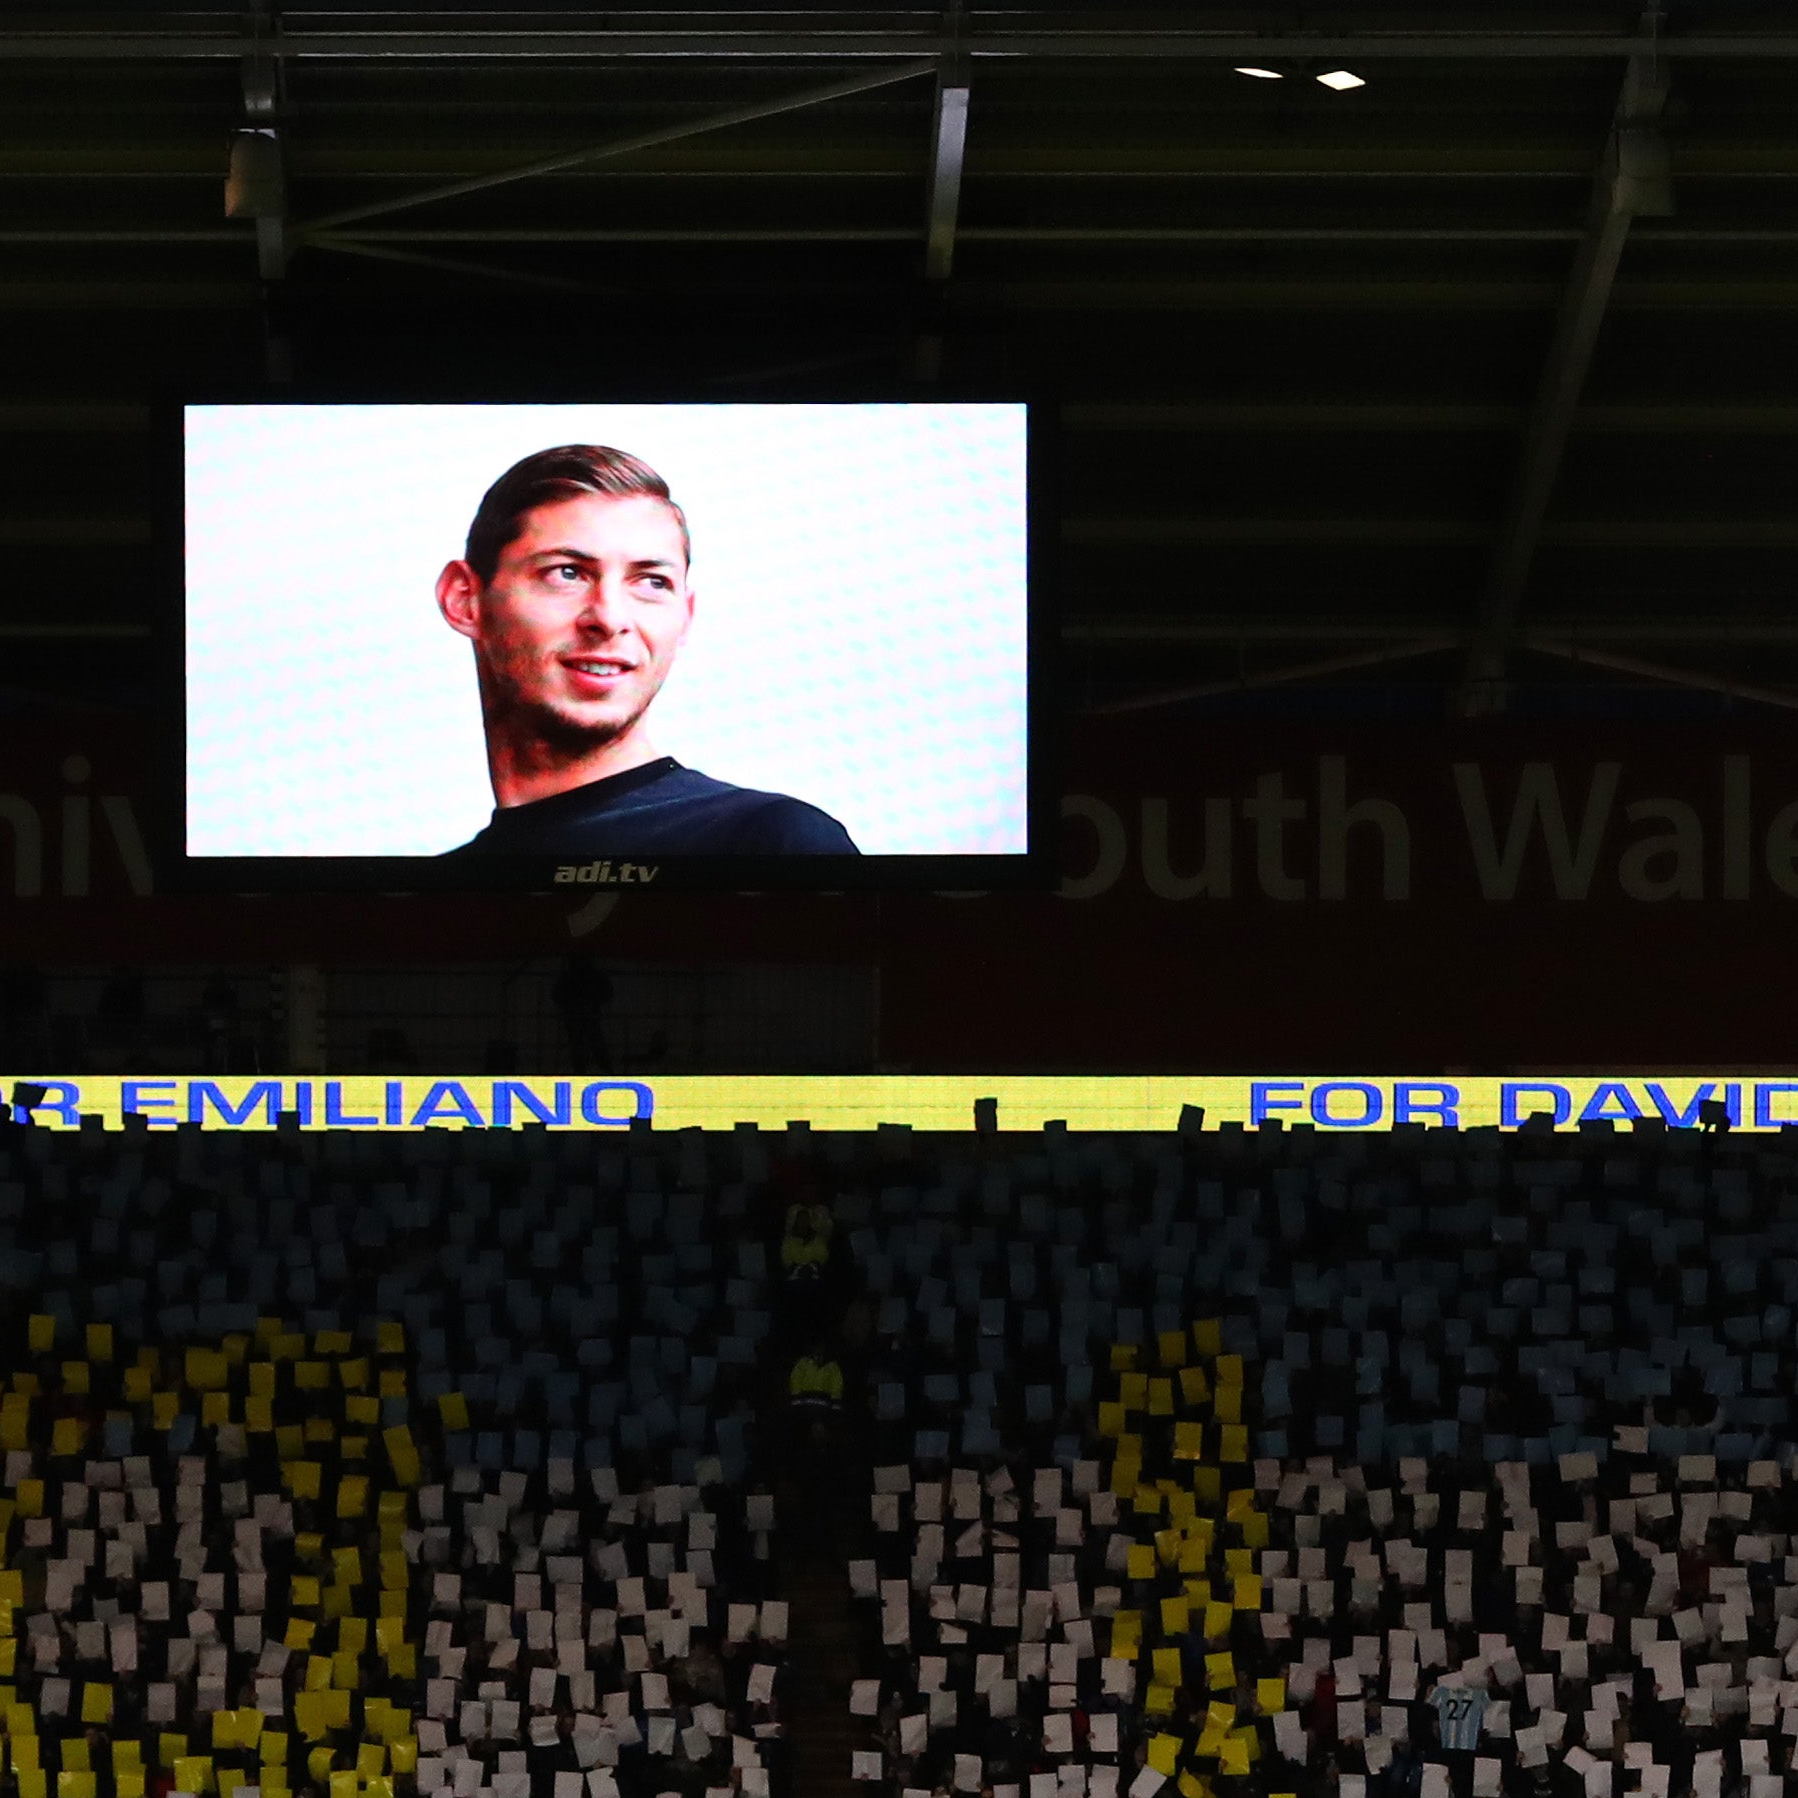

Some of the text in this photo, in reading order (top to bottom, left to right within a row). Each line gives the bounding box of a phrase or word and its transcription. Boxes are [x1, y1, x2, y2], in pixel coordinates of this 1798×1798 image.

[1055, 754, 1411, 902] outh
[553, 860, 659, 883] adi.tv
[121, 1082, 654, 1127] EMILIANO
[1251, 1082, 1459, 1127] FOR
[1446, 1699, 1474, 1721] 27
